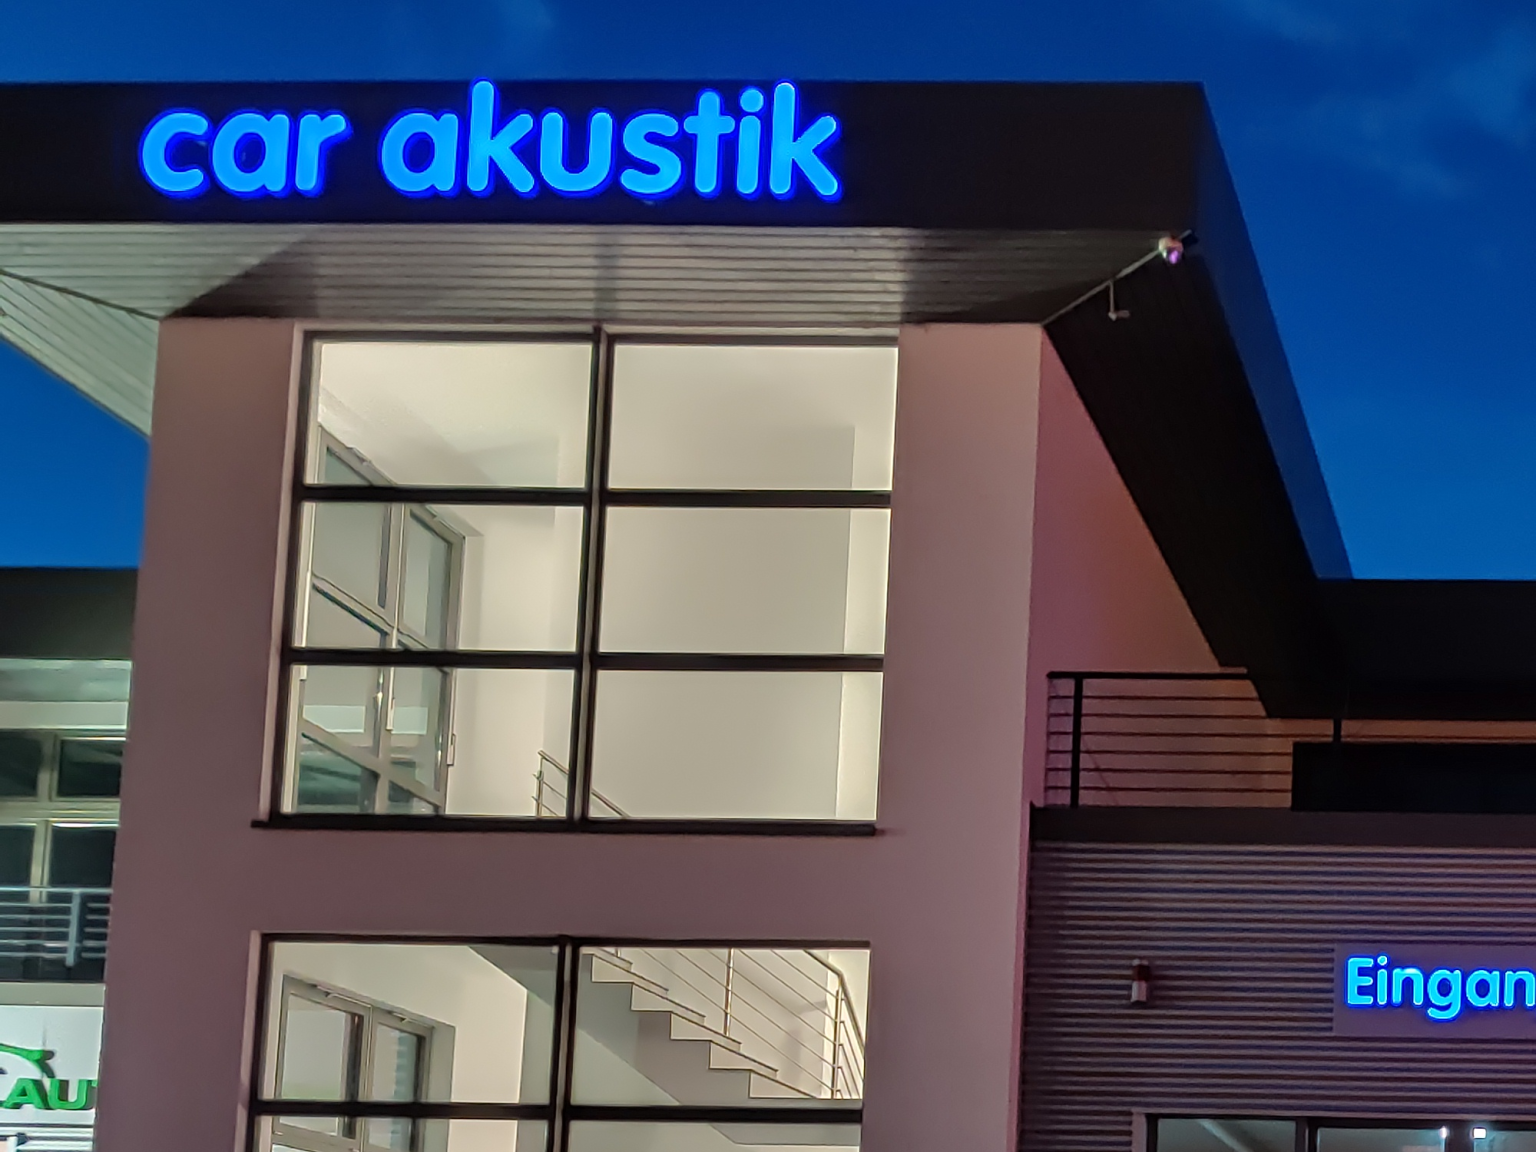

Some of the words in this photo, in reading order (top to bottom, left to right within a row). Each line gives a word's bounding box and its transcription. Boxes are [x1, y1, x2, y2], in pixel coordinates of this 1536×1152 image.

[140, 109, 351, 197] car
[379, 78, 841, 200] akustik
[2, 1077, 98, 1111] AU
